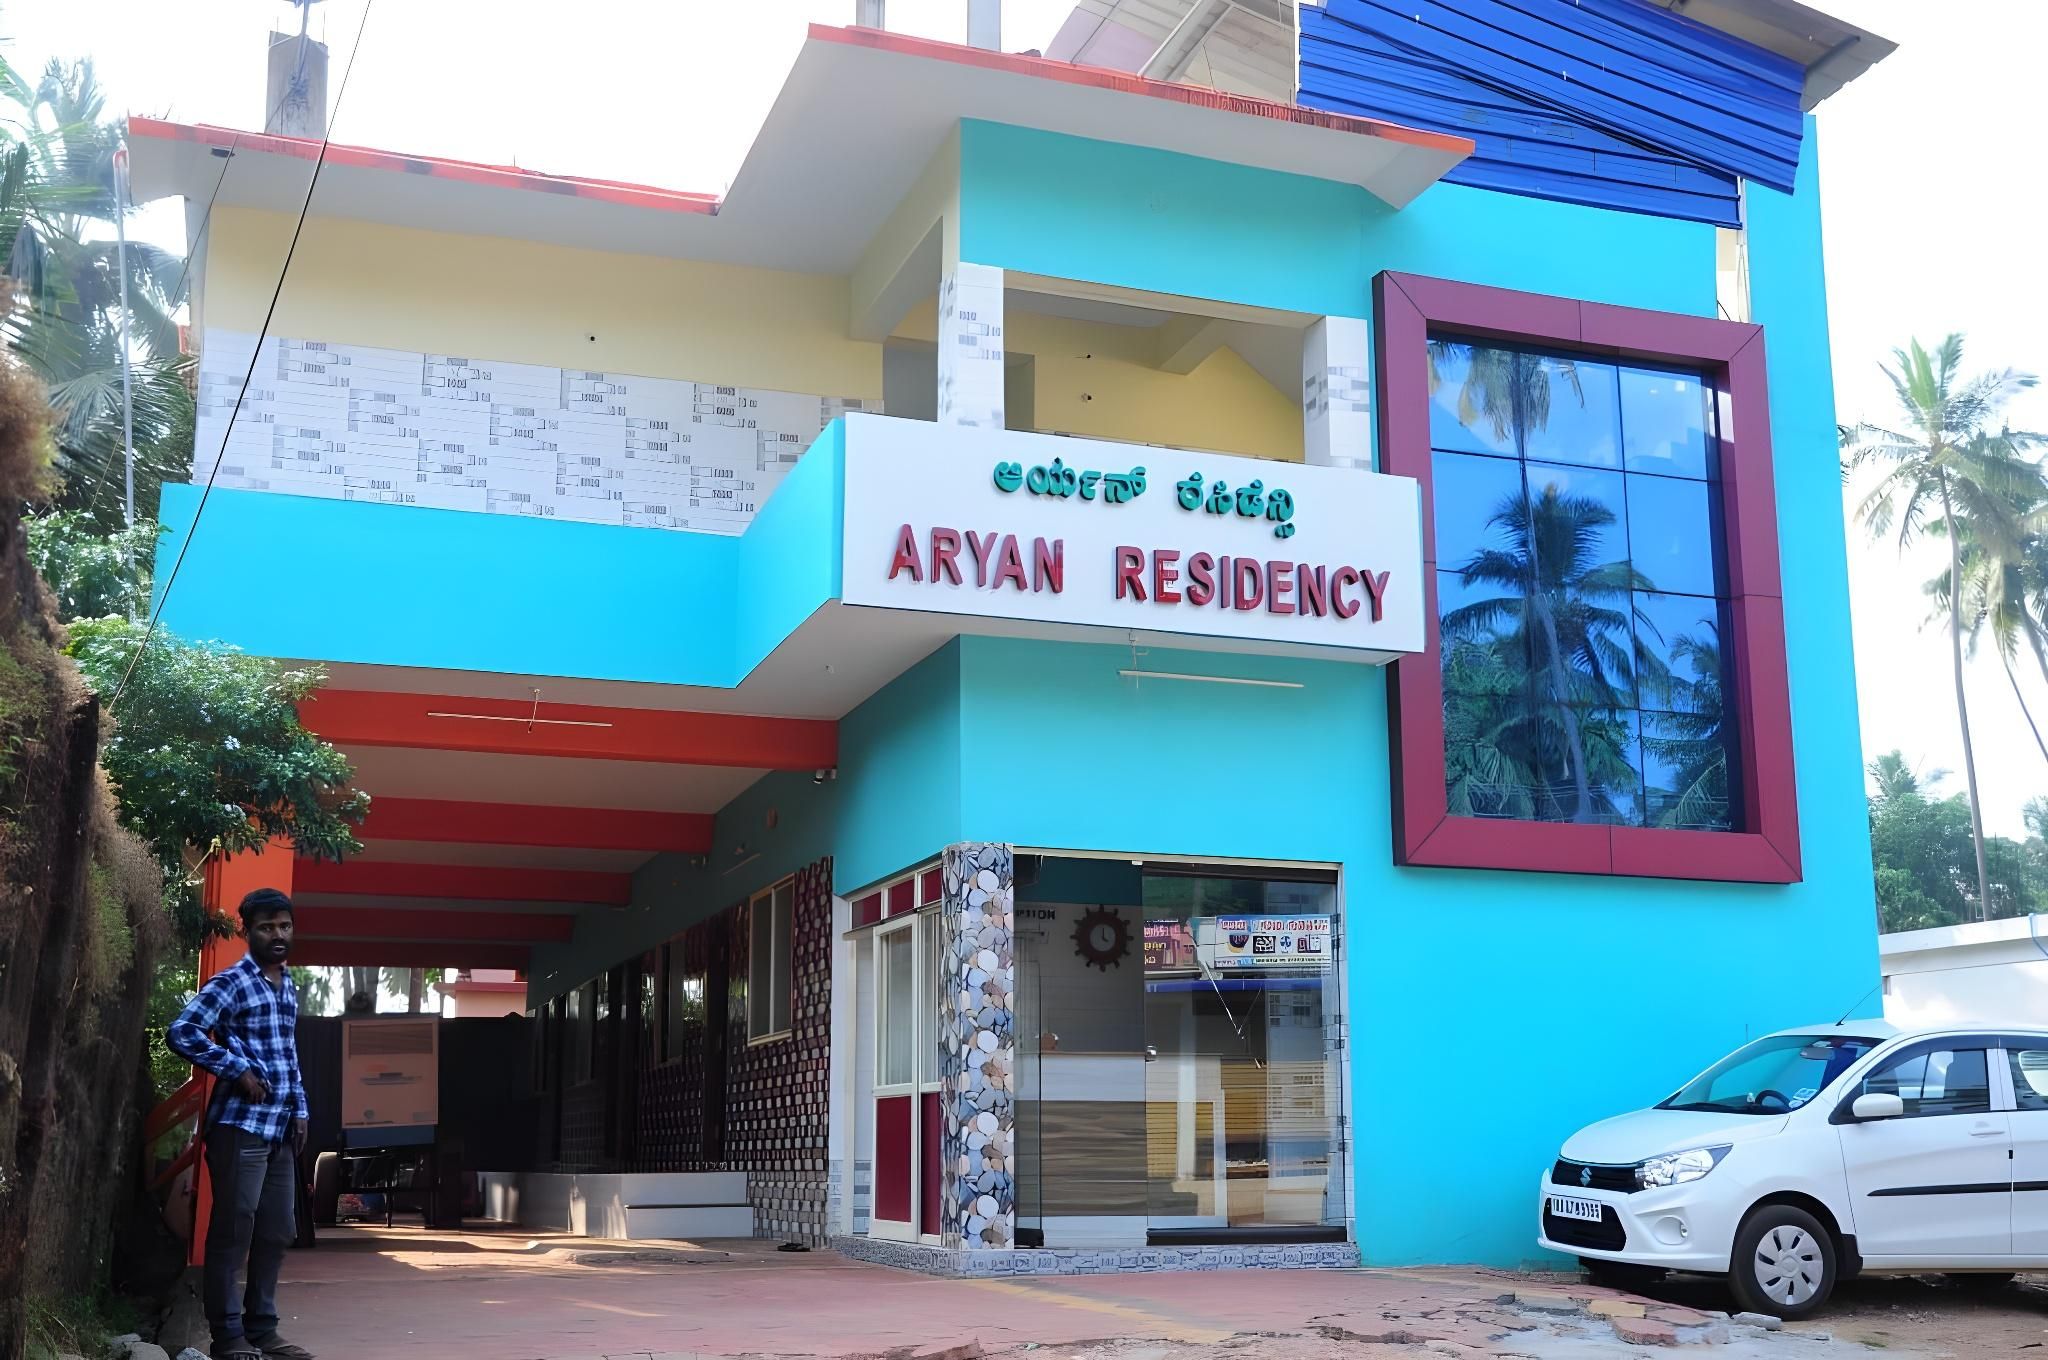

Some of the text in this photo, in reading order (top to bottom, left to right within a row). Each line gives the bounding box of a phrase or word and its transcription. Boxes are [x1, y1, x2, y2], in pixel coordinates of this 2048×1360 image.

[1177, 472, 1295, 539] ರೆಸಿಡೆನ್ಸಿ
[888, 523, 1390, 623] ARYAN RESIDENCY
